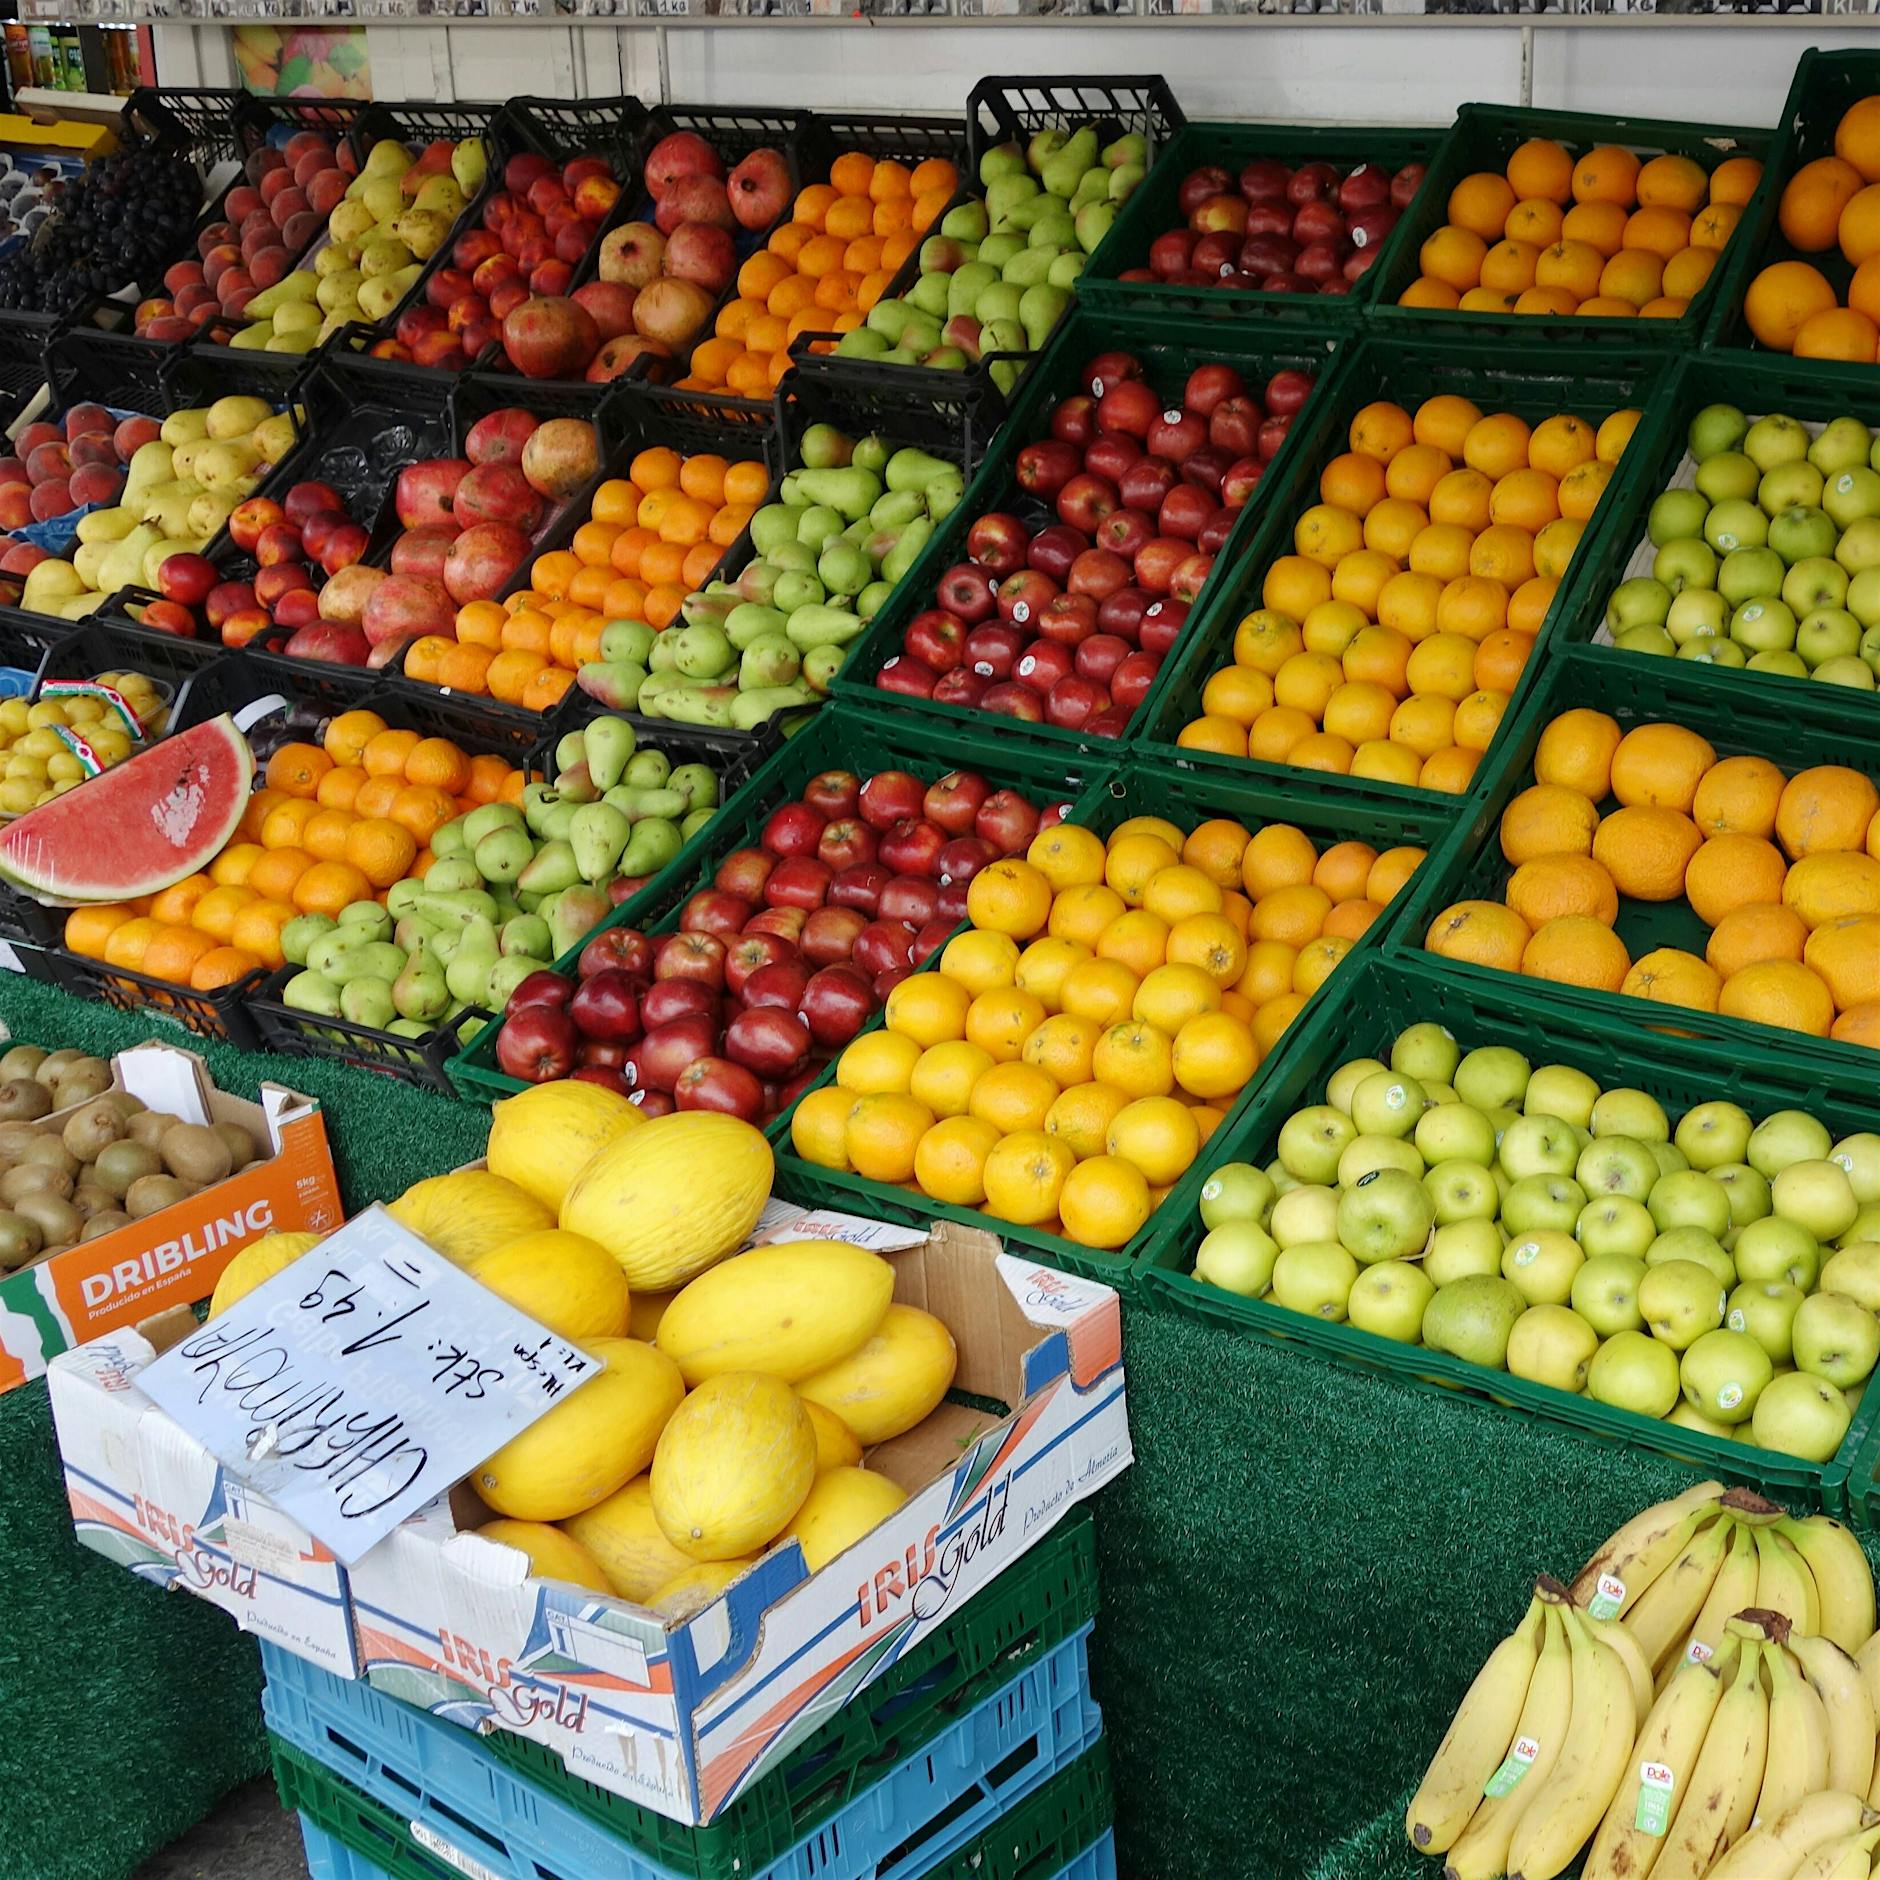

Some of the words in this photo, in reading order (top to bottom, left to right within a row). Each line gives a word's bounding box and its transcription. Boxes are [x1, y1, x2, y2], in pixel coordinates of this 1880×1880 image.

[80, 1199, 274, 1308] DRIBLING
[88, 1291, 141, 1321] Producido
[142, 1283, 155, 1297] en
[155, 1266, 192, 1290] España
[299, 1270, 430, 1355] 1.49
[539, 1337, 552, 1349] 1
[133, 1494, 196, 1552] IRIS
[1023, 1491, 1063, 1536] Producto
[1065, 1480, 1075, 1495] de
[911, 1469, 1012, 1621] Gold
[175, 1550, 259, 1600] Gold
[857, 1523, 941, 1629] IRIS
[1602, 1580, 1623, 1598] Dole
[438, 1627, 514, 1689] IRIS
[1692, 1646, 1710, 1661] Dol
[488, 1685, 589, 1734] Gold
[1517, 1741, 1537, 1758] Dole
[1647, 1767, 1671, 1784] Dole
